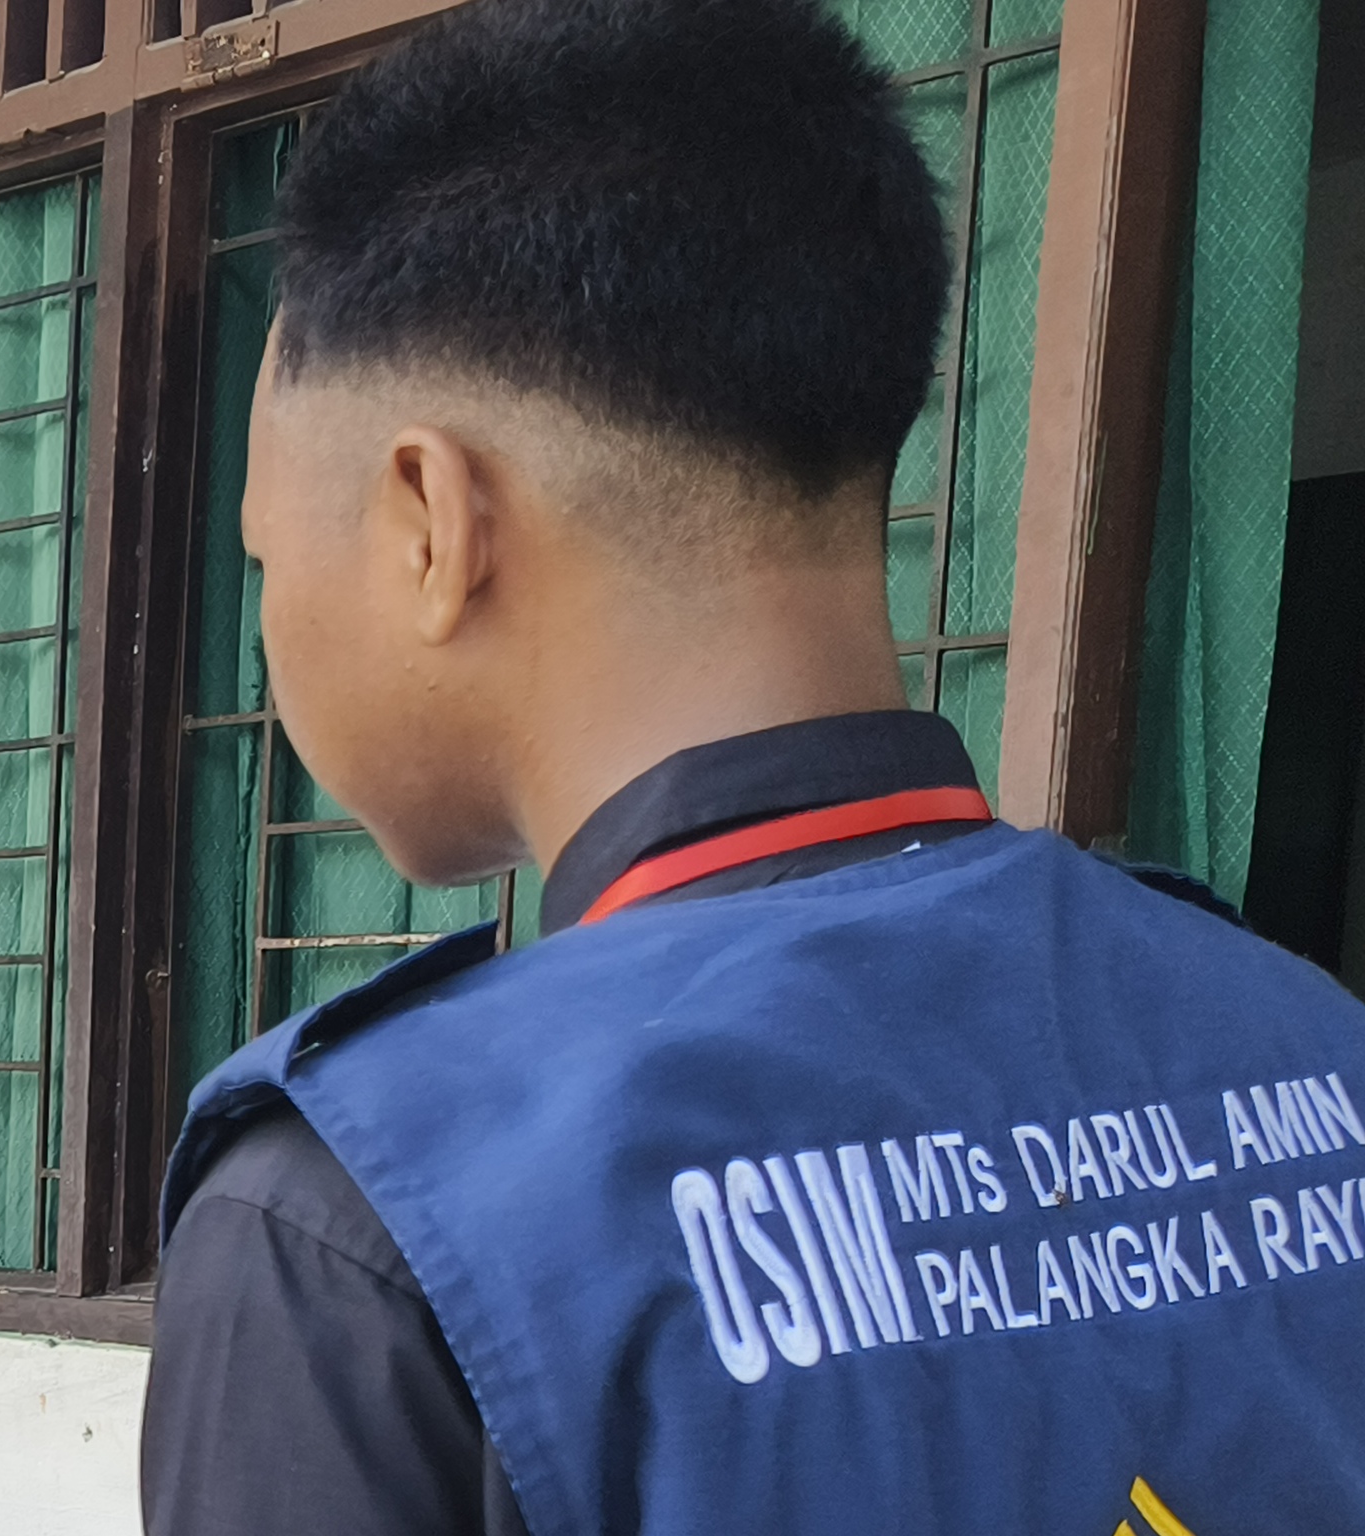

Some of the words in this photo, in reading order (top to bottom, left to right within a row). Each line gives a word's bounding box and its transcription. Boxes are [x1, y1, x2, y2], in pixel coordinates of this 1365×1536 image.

[880, 1130, 1007, 1223] MTs
[1011, 1102, 1218, 1207] DARUL
[1222, 1072, 1365, 1170] AMIN
[670, 1141, 924, 1385] OSIM
[915, 1209, 1248, 1337] PALANGKA
[1249, 1178, 1365, 1282] RAY
